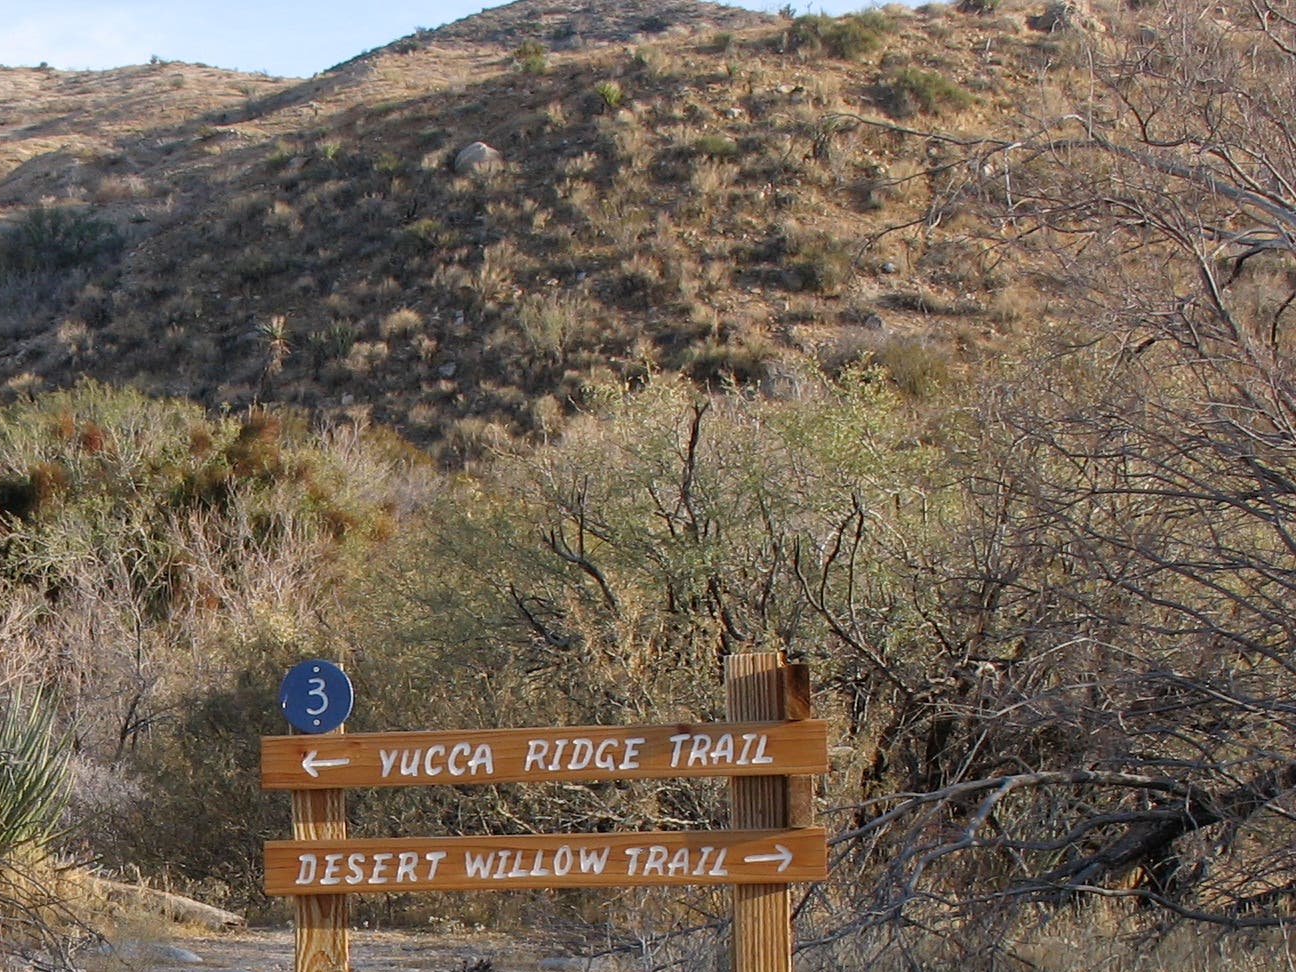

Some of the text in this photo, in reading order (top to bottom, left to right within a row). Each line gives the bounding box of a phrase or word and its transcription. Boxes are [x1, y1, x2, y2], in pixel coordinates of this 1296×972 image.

[306, 677, 329, 716] 3
[380, 733, 774, 778] YUCCA RIDGE TRAIL
[295, 844, 729, 885] DESERT WILLOW TRAIL
